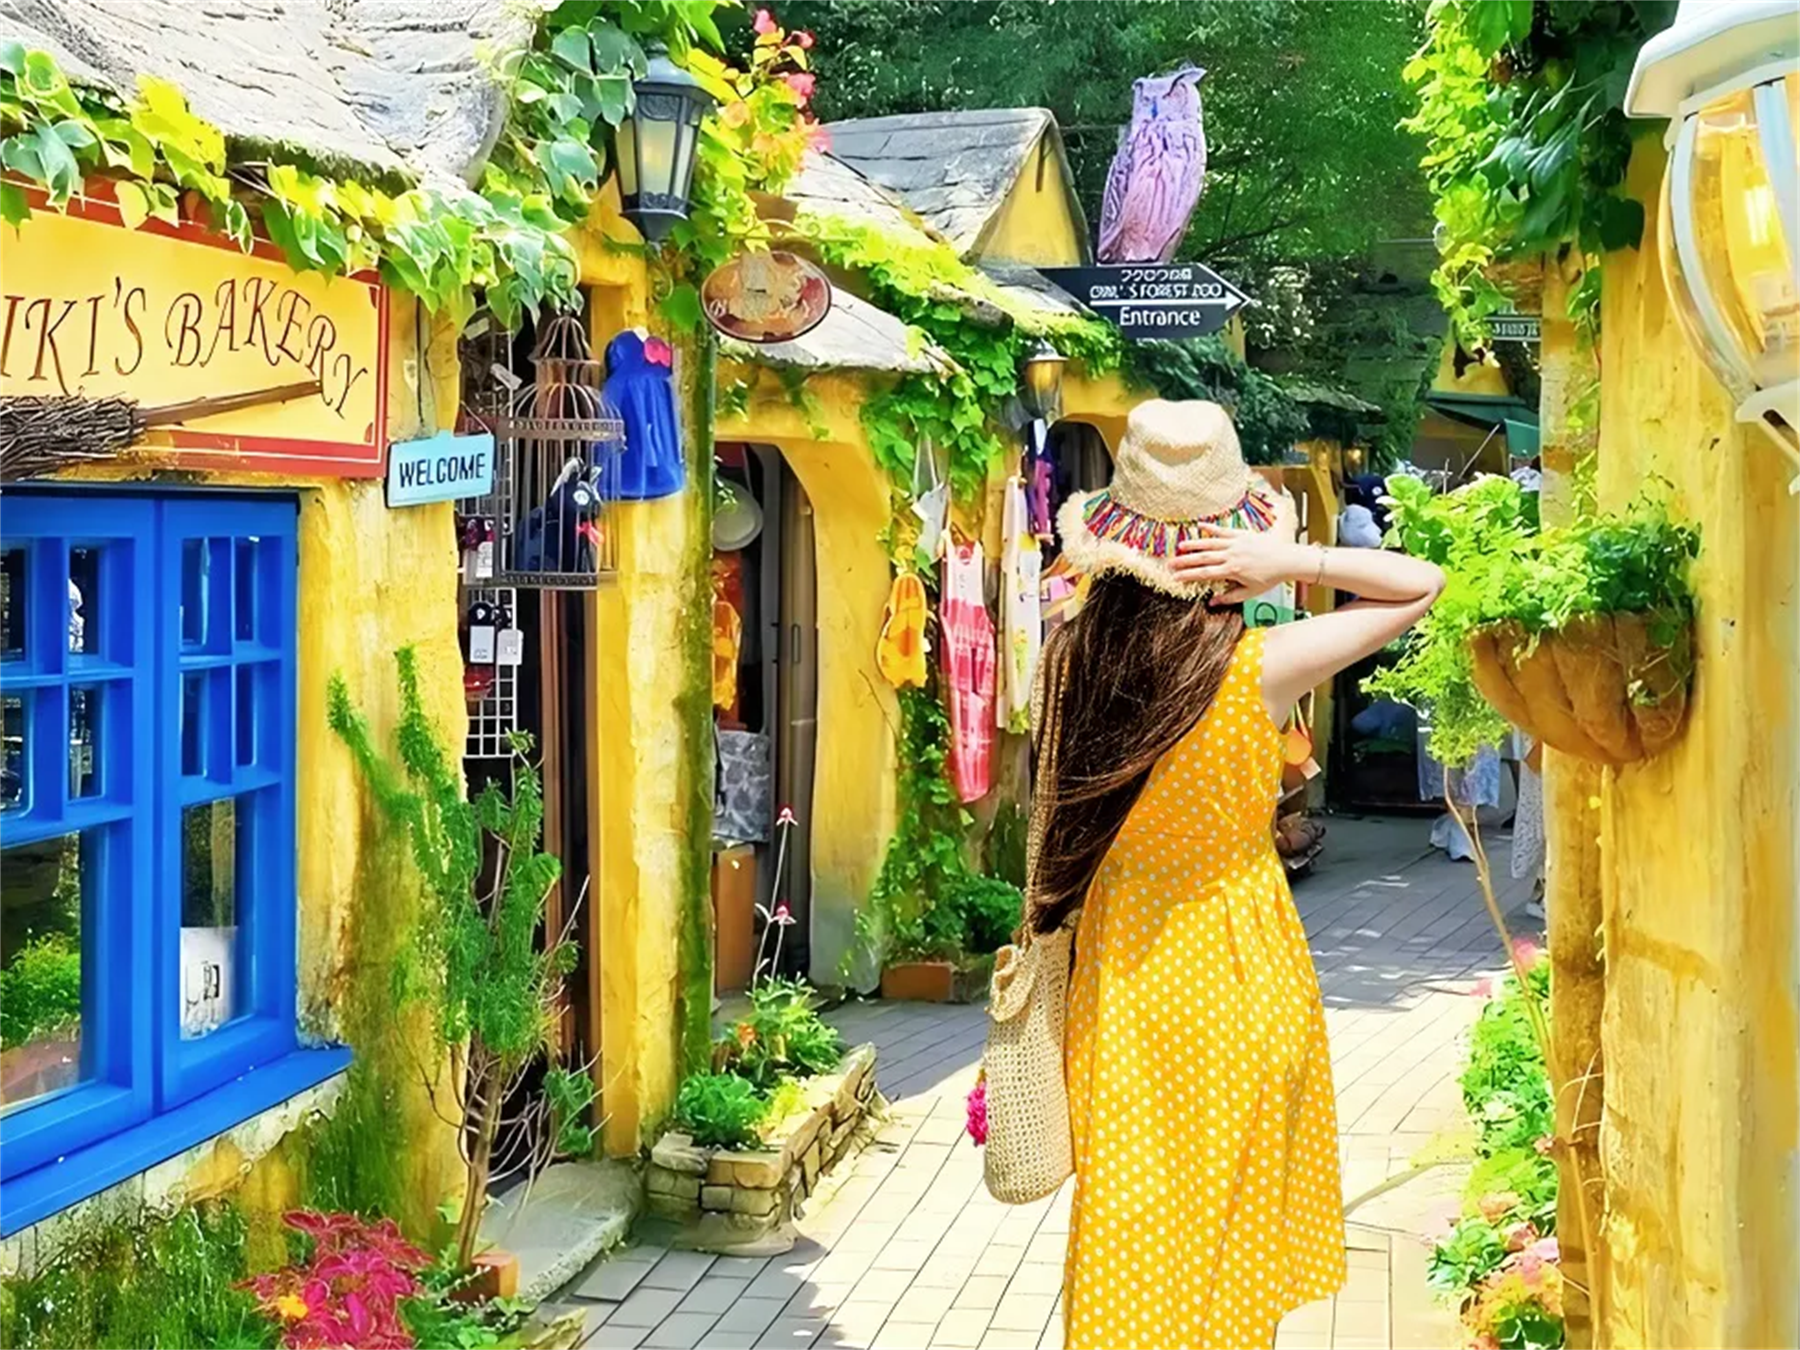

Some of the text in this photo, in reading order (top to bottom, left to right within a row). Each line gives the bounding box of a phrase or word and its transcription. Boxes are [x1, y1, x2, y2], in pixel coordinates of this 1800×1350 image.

[1120, 306, 1200, 326] Entrance
[165, 277, 368, 419] BAKERY
[399, 453, 485, 488] WELCOME
